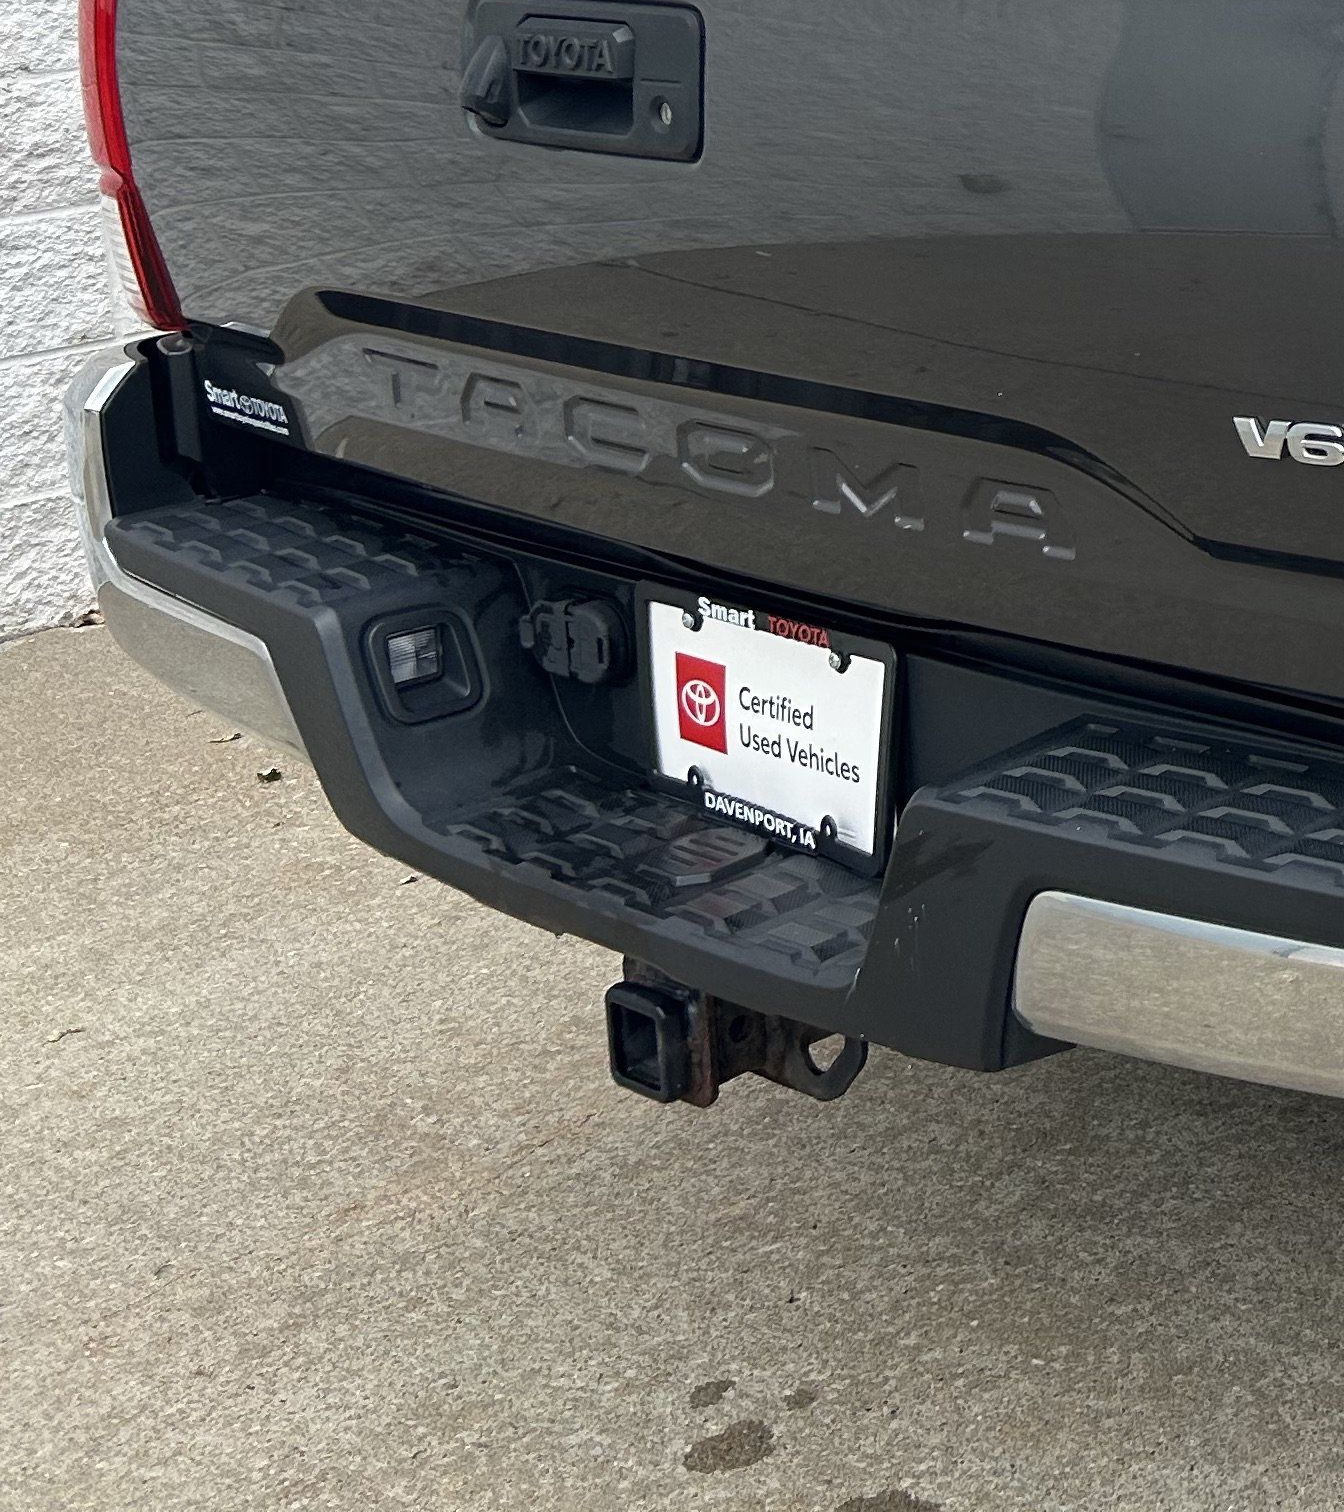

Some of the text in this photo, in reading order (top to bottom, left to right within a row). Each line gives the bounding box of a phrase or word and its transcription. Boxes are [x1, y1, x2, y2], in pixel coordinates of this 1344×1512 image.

[515, 34, 614, 73] TOYOTA
[204, 379, 241, 410] Smart
[361, 347, 1076, 561] TACOMA
[698, 596, 831, 648] Smart TOYOTA
[739, 686, 815, 730] Certified
[739, 723, 861, 783] Used Vehicles
[704, 791, 816, 850] DAVENPORT, IA
